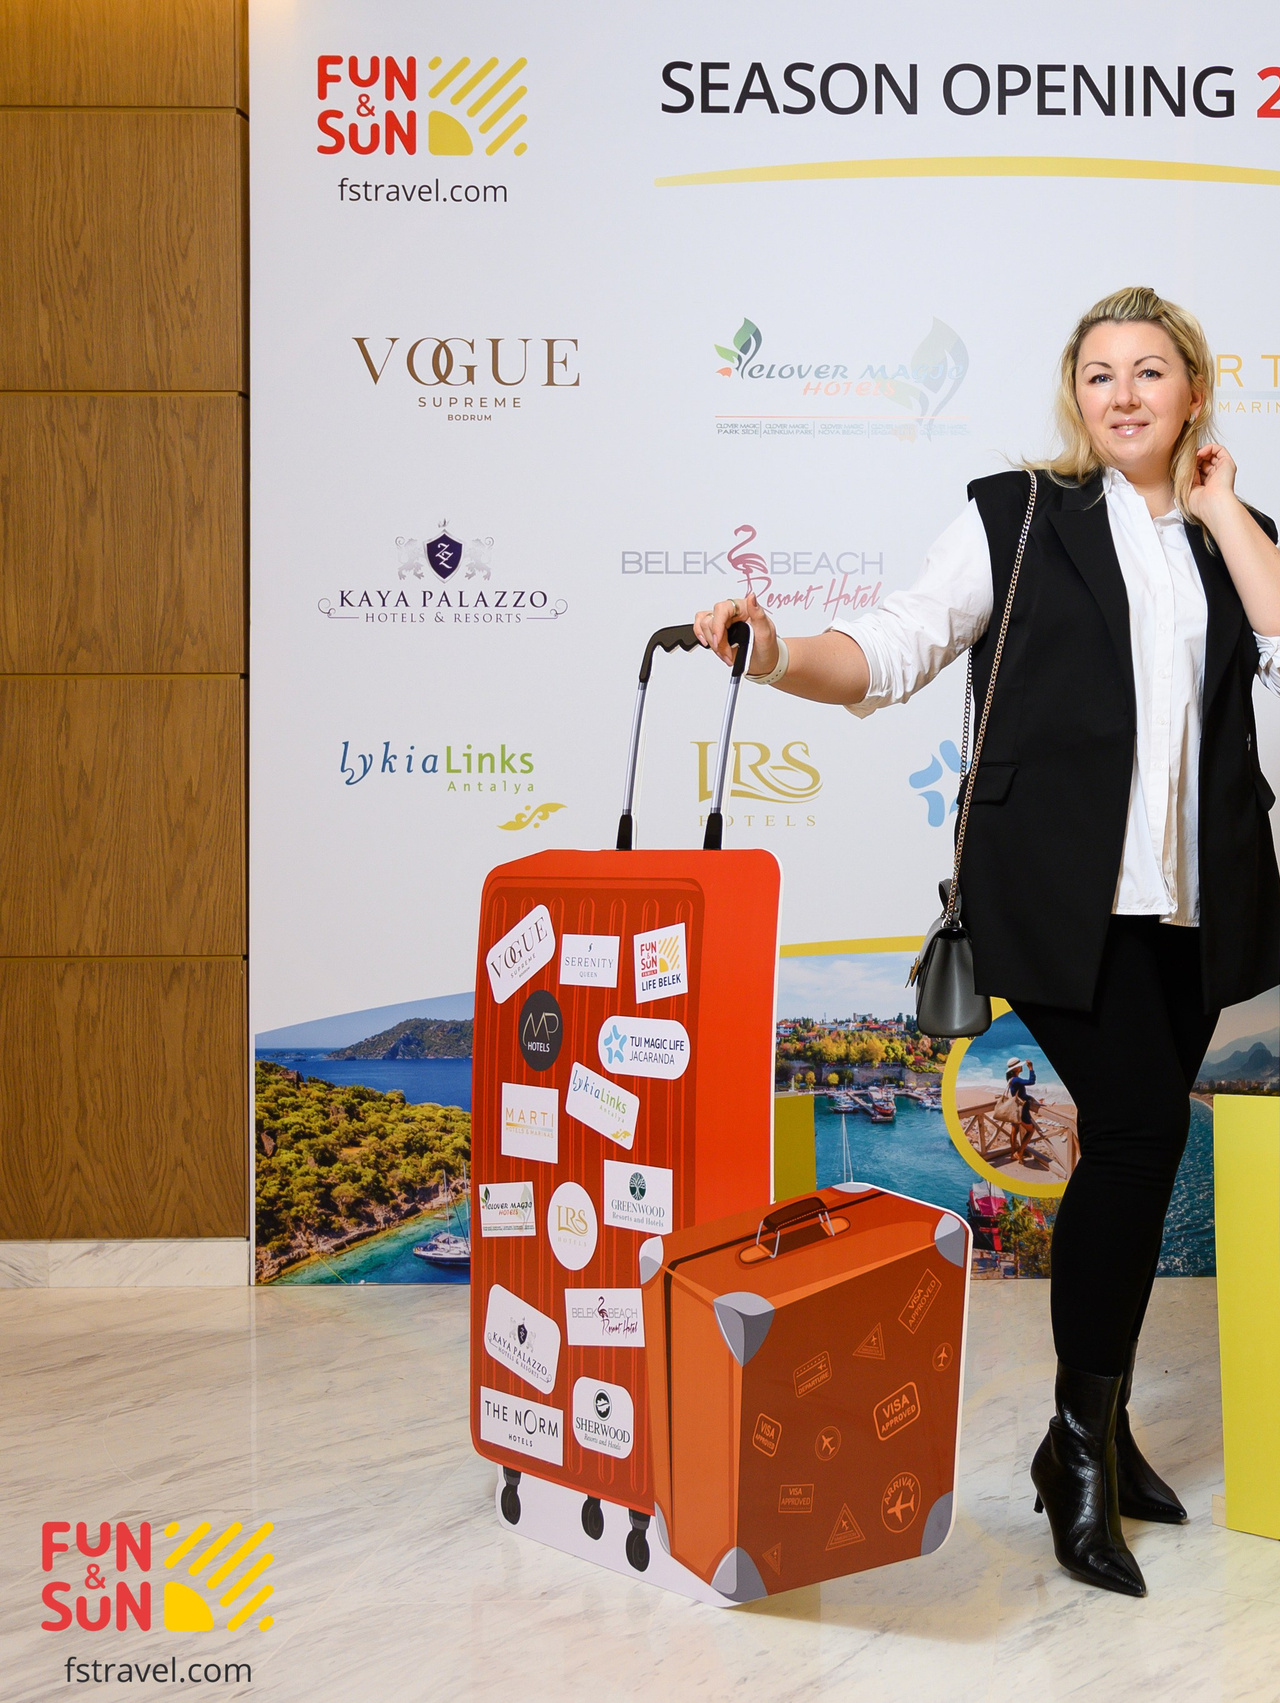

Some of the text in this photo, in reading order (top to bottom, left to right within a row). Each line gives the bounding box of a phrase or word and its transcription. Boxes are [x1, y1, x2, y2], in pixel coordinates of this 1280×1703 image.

[317, 55, 417, 100] FUN
[660, 60, 918, 115] SEASON
[942, 61, 1236, 119] OPENING
[355, 92, 376, 117] &
[317, 109, 417, 156] SUN
[337, 177, 508, 204] fstravel.com
[352, 336, 581, 388] VOGUE
[748, 363, 965, 381] CLOVER MAGIC
[802, 381, 897, 397] HOTELS
[418, 396, 522, 409] SUPREME
[621, 551, 884, 575] BELEK BEACH
[339, 590, 548, 609] KAYA PALAZZO
[737, 573, 882, 620] Resort Hotel
[365, 611, 522, 623] HOTELS & RESORTS
[690, 741, 823, 803] LRS
[447, 781, 534, 794] Antalya
[491, 916, 547, 978] VOGUE
[640, 941, 656, 956] FUN
[510, 952, 536, 978] SUPREME
[565, 957, 614, 968] SERENITY
[641, 956, 657, 970] SUN
[642, 979, 656, 991] LIFE
[658, 973, 681, 987] BELEK
[527, 1041, 550, 1053] HOTELS
[630, 1036, 684, 1051] TUI MAGIC LIFE
[629, 1050, 675, 1065] JACARANDA
[506, 1107, 553, 1127] MARTI
[600, 1105, 626, 1124] Antalya
[530, 1130, 553, 1138] MARINAS
[611, 1199, 665, 1218] GREENWOOD
[556, 1205, 588, 1236] LRS
[612, 1212, 664, 1227] Resorts and Hotels
[558, 1237, 587, 1247] HOTELS
[908, 1289, 924, 1309] VISA
[908, 1280, 936, 1327] APPROVED
[572, 1307, 638, 1319] BELEK BEACH
[493, 1332, 547, 1375] KAYA PALAZZO
[798, 1371, 829, 1395] DEPARTURE
[882, 1394, 909, 1418] VISA
[485, 1400, 559, 1438] THE NORM
[881, 1404, 916, 1433] APPROVED
[575, 1417, 630, 1443] SHERWOOD
[761, 1421, 775, 1439] VISA
[508, 1434, 533, 1447] HOTELS
[755, 1433, 775, 1450] APPROVED
[884, 1476, 916, 1505] ARRIVAL
[781, 1497, 810, 1505] APPROVED
